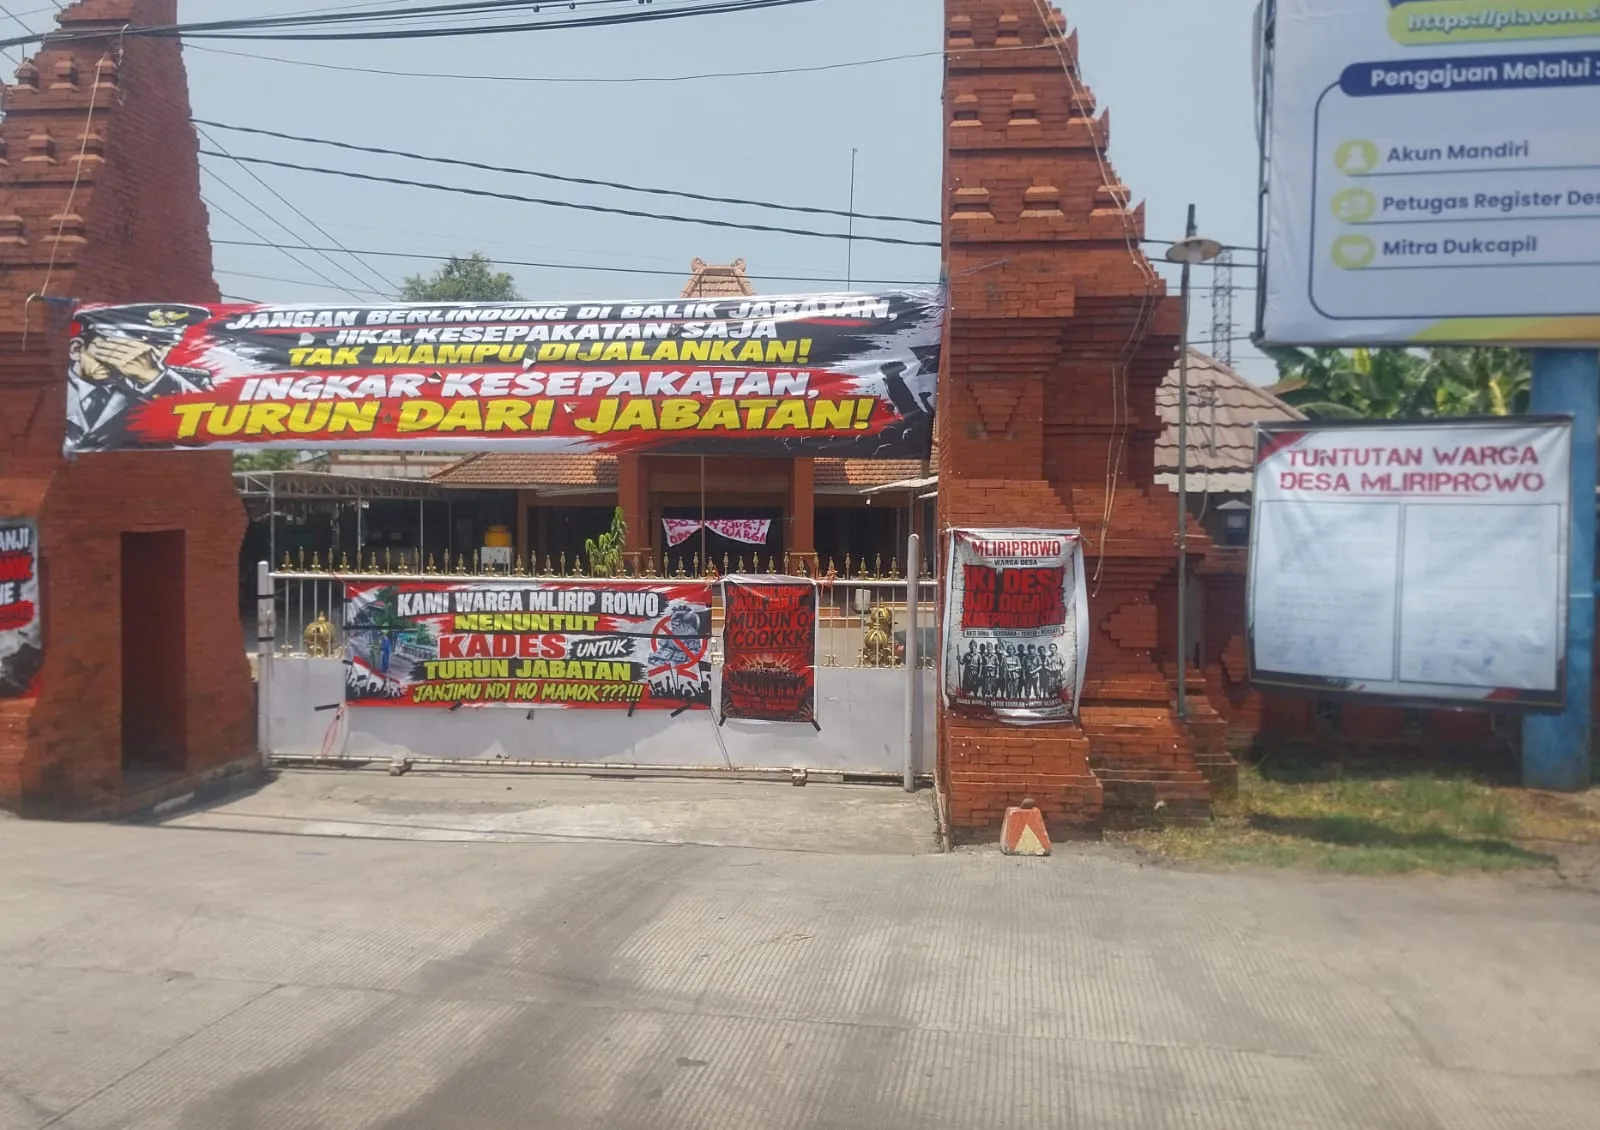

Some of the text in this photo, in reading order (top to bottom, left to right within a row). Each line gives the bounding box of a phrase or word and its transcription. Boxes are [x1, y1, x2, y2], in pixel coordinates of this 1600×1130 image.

[1409, 7, 1600, 34] https://plavon.s
[1371, 64, 1497, 90] Pengajuan
[1503, 57, 1591, 81] Melalui
[1387, 141, 1529, 162] Akun Mandiri
[1383, 195, 1468, 214] Petugas
[1474, 191, 1562, 212] Register
[1383, 236, 1537, 257] Mitra Dukcapil
[225, 310, 359, 330] JANGAN
[364, 307, 568, 326] BERLINDUNG
[576, 306, 613, 320] DI
[620, 303, 718, 319] BALIK
[413, 322, 672, 345] KESEPAKATAN
[680, 320, 778, 339] SAJA
[289, 338, 813, 367] TAK MAMPU DIJALANKAN!
[238, 371, 819, 402] INGKAR KESEPAKATAN,
[173, 397, 876, 440] TURUN DARI JABATAN!
[1288, 446, 1539, 467] TUNTUTAN WARGA
[1280, 472, 1545, 493] DESA MLIRIPROWO
[971, 540, 1061, 557] MLIRIPROWO
[397, 591, 660, 617] KAMI WARGA MLIRIP ROWO
[455, 614, 599, 633] MENUNTUT
[437, 633, 628, 660] KADES UNTUK
[424, 660, 632, 681] TURUN JABATAN
[413, 682, 481, 703] JANJIMU
[485, 683, 510, 701] NDI
[516, 683, 537, 700] MO
